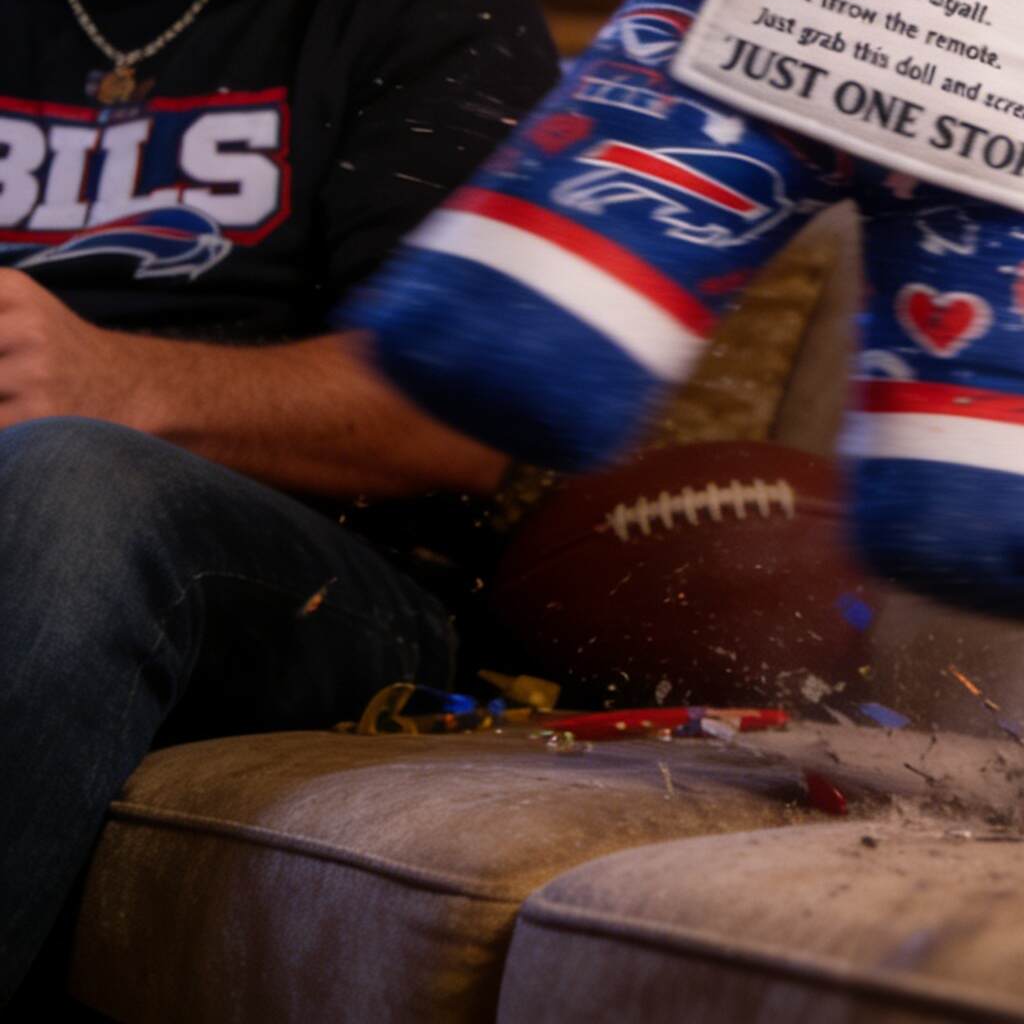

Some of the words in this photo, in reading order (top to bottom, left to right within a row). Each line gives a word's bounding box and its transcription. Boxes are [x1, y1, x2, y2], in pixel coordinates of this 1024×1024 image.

[884, 11, 920, 40] the
[894, 55, 937, 86] doll
[940, 77, 983, 102] and
[832, 79, 926, 139] ONE
